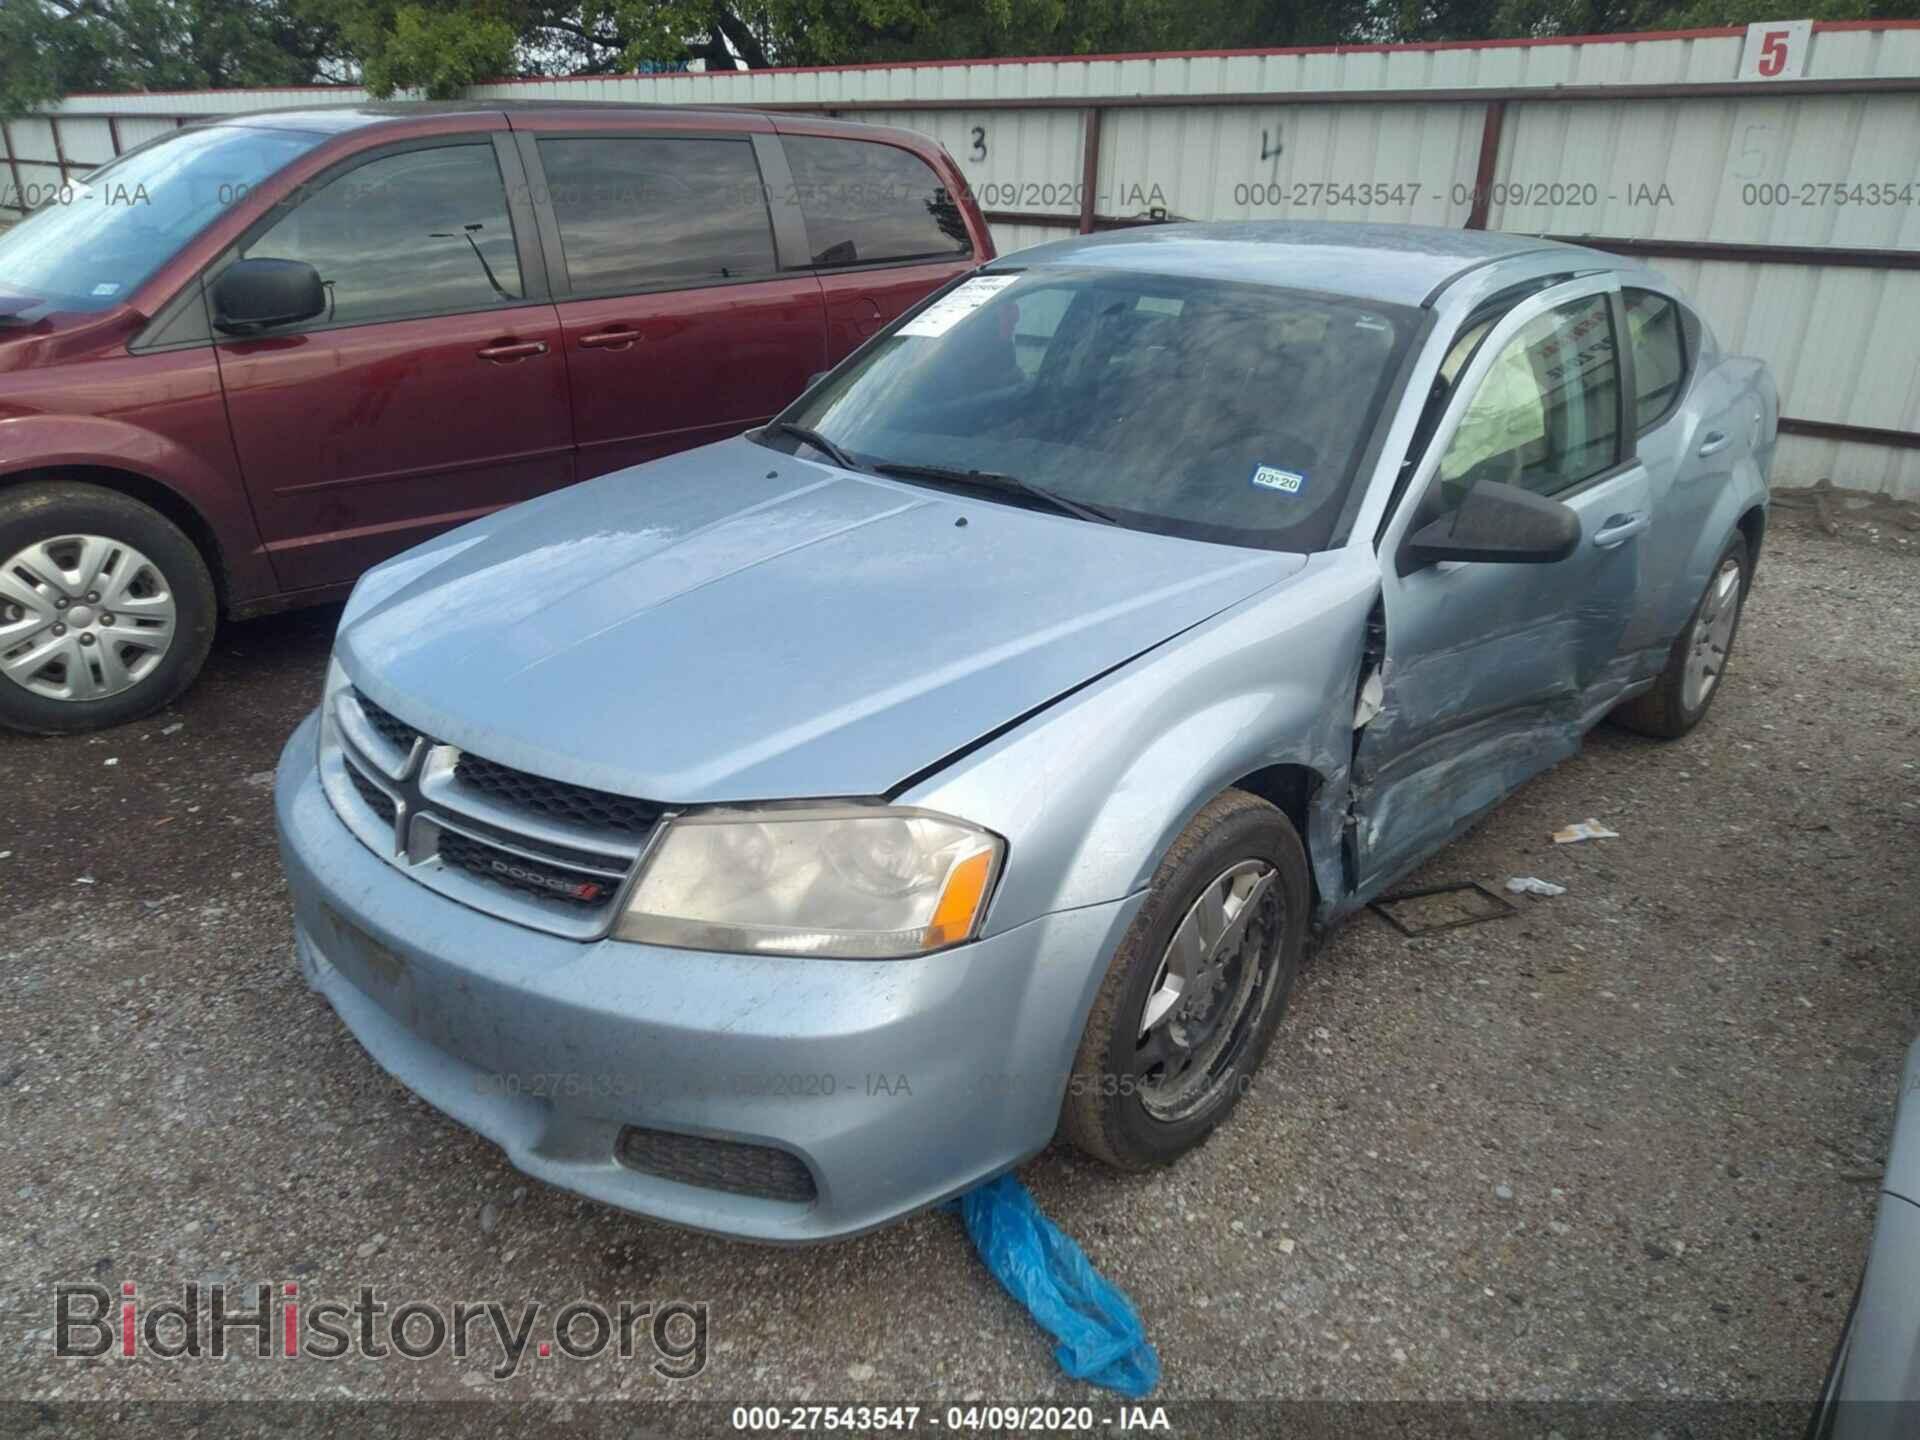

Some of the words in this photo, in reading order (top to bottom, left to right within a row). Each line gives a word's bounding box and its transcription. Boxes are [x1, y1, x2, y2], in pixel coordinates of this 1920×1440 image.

[1758, 31, 1790, 77] 5
[969, 126, 988, 163] 3
[1260, 124, 1283, 187] 4
